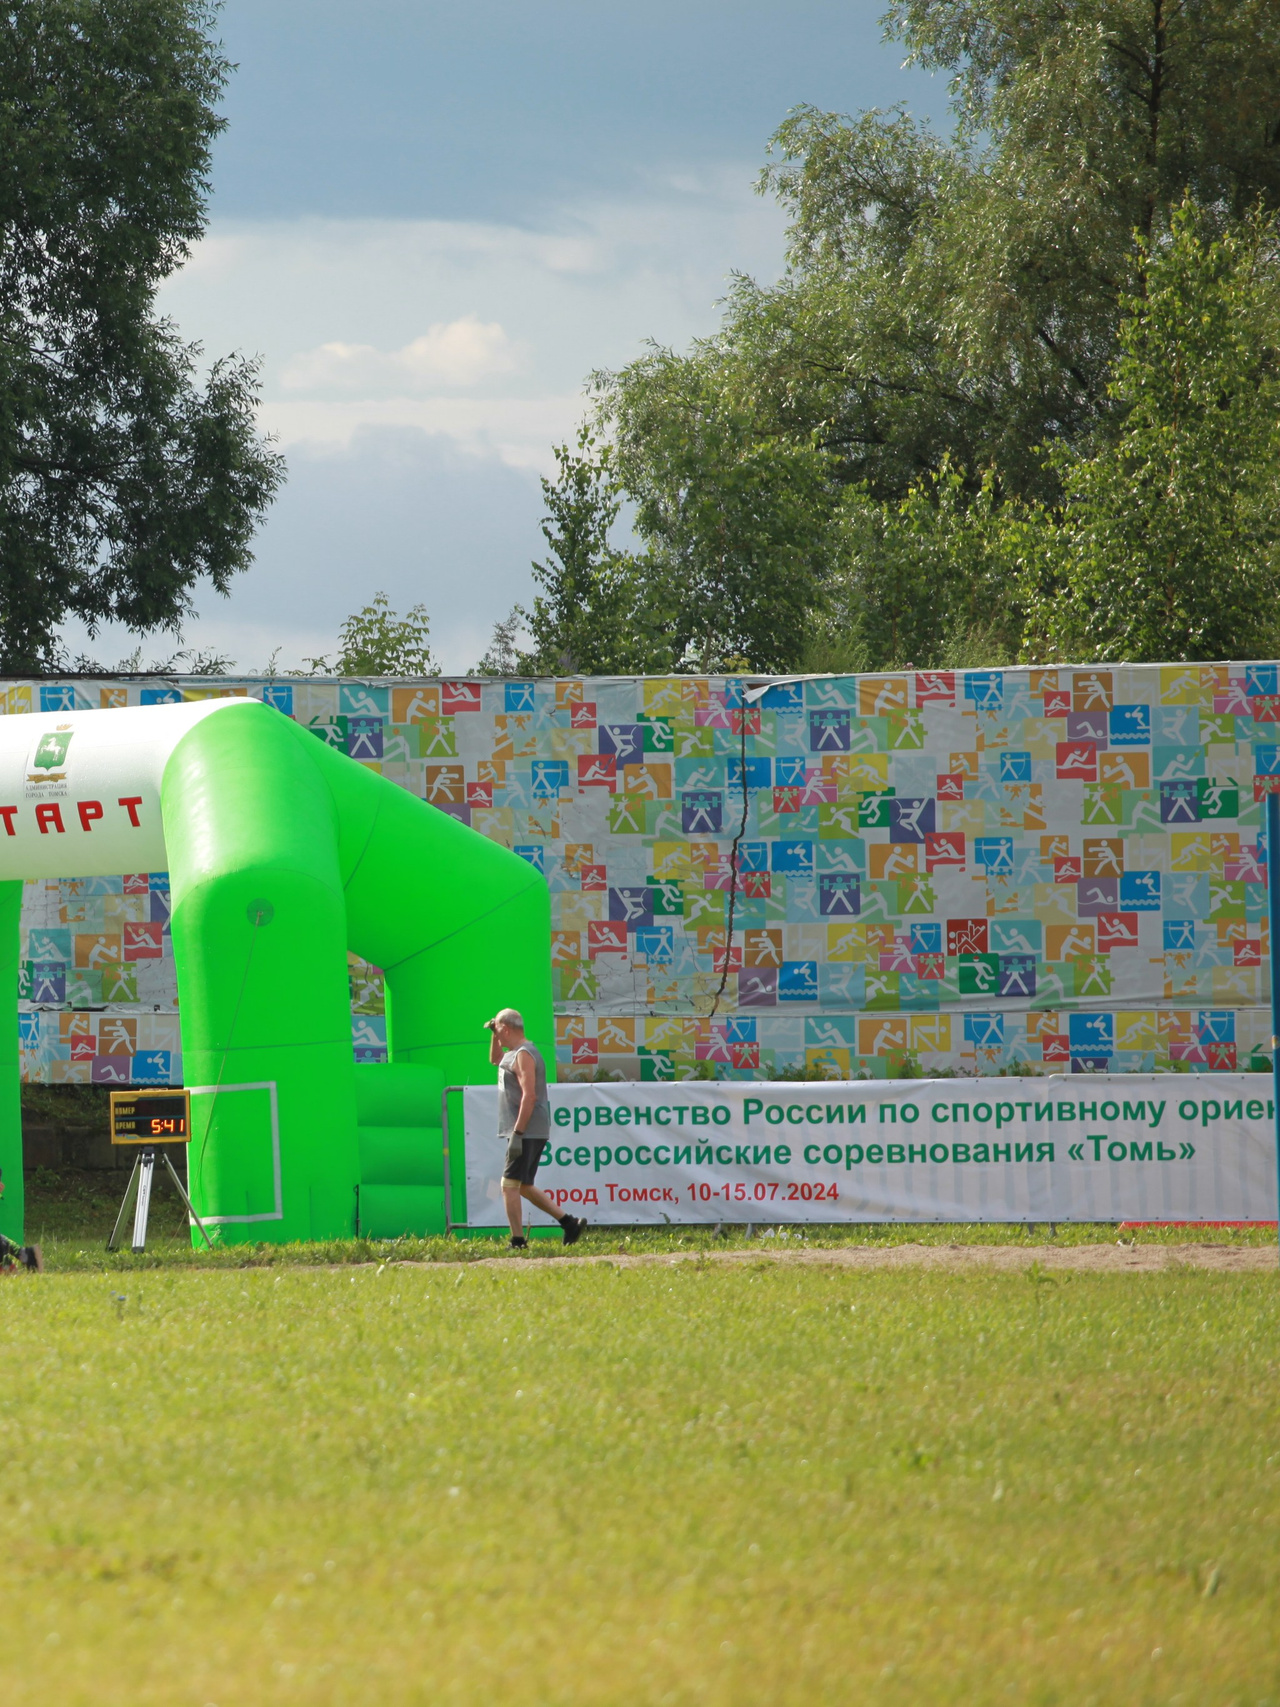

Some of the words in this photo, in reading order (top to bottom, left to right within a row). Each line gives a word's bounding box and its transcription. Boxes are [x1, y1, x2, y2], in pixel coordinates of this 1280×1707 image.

[548, 1101, 732, 1134] ервенство
[743, 1097, 867, 1126] России
[878, 1102, 920, 1124] по
[930, 1100, 1166, 1130] спортивному
[803, 1141, 1055, 1171] соревнования
[1067, 1134, 1196, 1163] «Томь»
[543, 1188, 599, 1206] ород
[605, 1183, 679, 1204] Томск,
[687, 1182, 840, 1201] 10-15.07.2024
